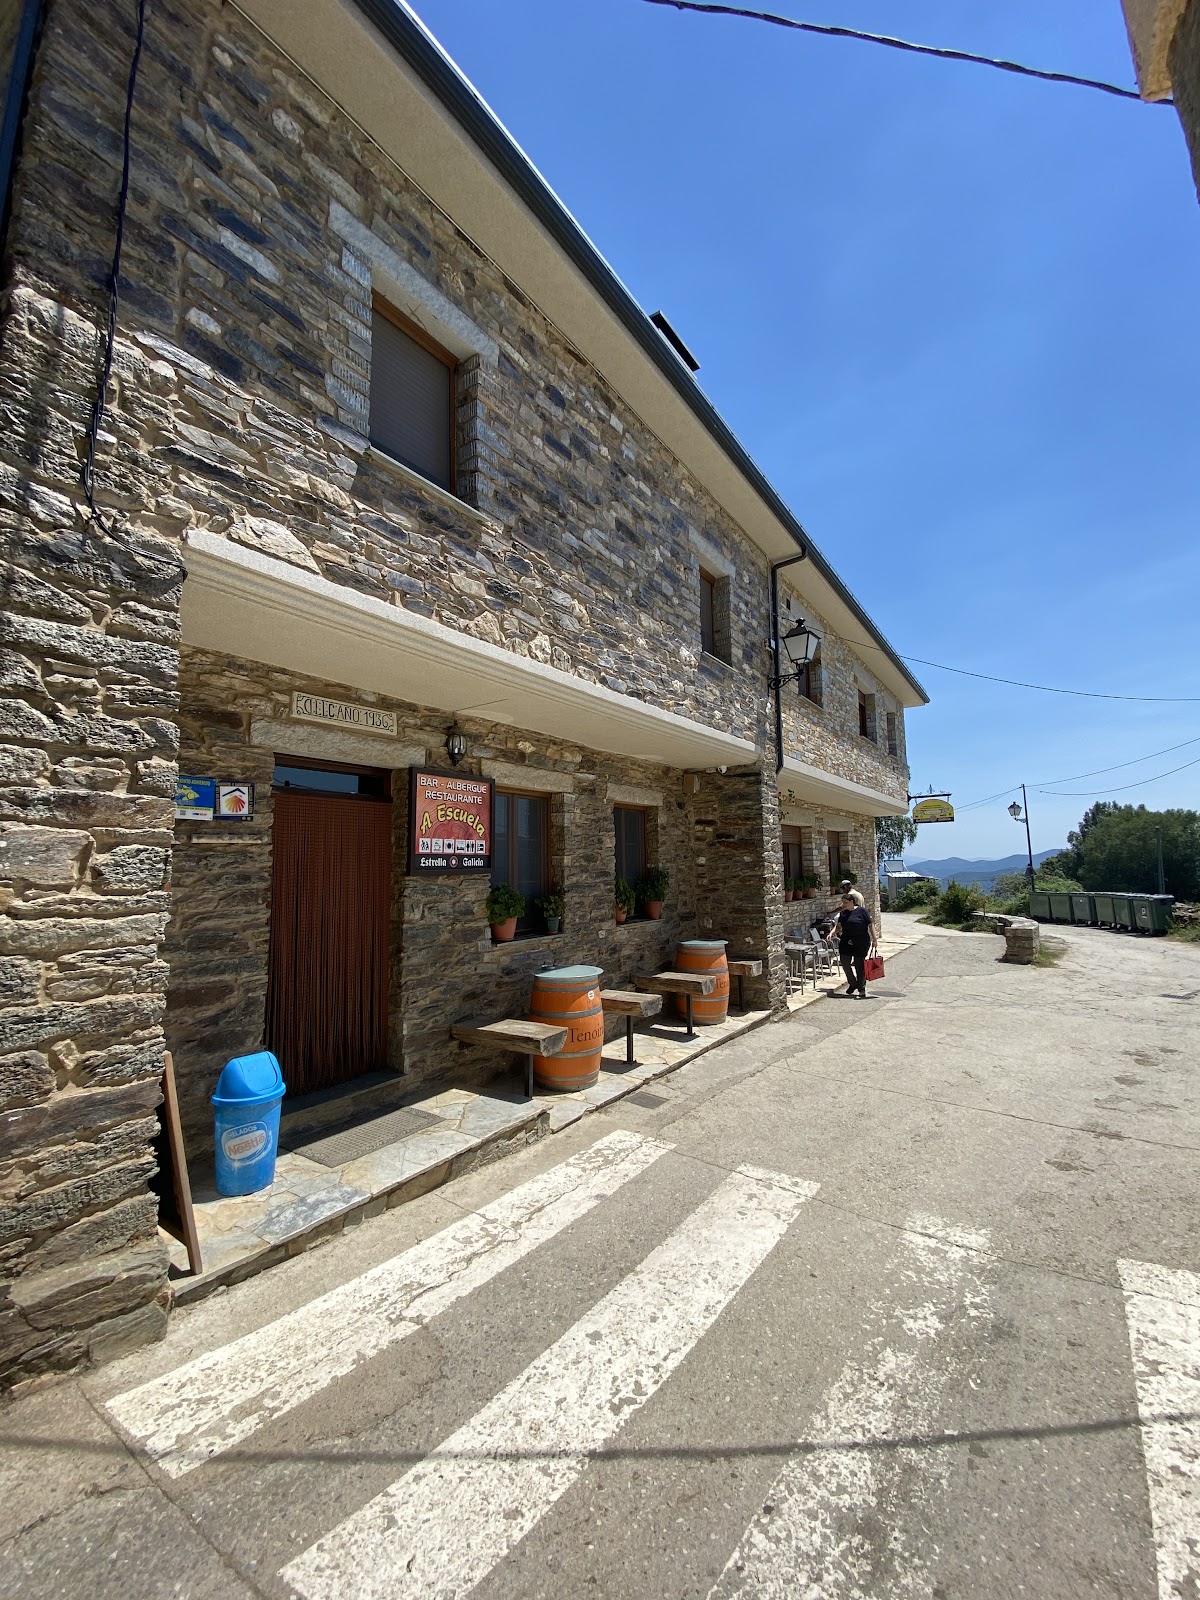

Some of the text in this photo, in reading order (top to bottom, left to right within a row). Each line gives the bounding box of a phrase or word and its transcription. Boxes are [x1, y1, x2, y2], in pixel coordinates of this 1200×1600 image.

[420, 776, 438, 787] BAR
[446, 781, 487, 793] ALBERGUE
[425, 790, 482, 804] RESTAURANTE
[420, 803, 485, 837] A Escuela
[420, 857, 484, 867] Estrella Galicia
[227, 1124, 258, 1137] HELADOS
